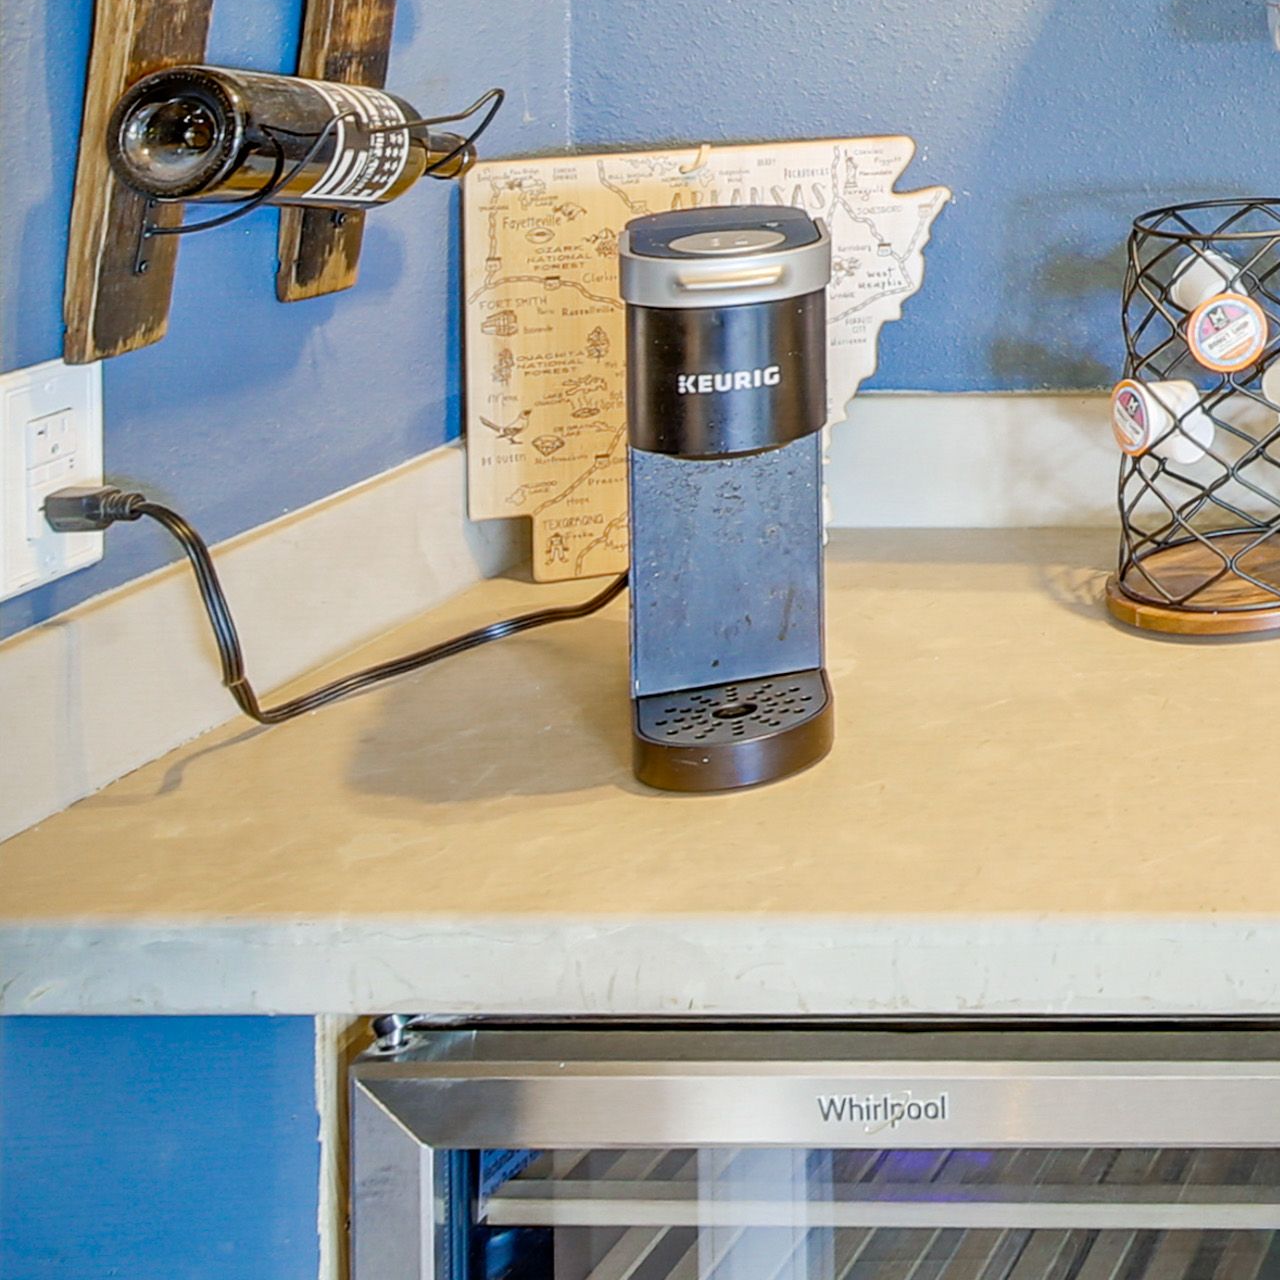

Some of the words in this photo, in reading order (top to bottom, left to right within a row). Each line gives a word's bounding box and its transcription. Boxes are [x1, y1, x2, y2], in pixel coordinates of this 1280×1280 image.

[503, 215, 561, 231] Fayetteville
[678, 365, 781, 395] KEURIG
[817, 1094, 946, 1128] Whirlpool
